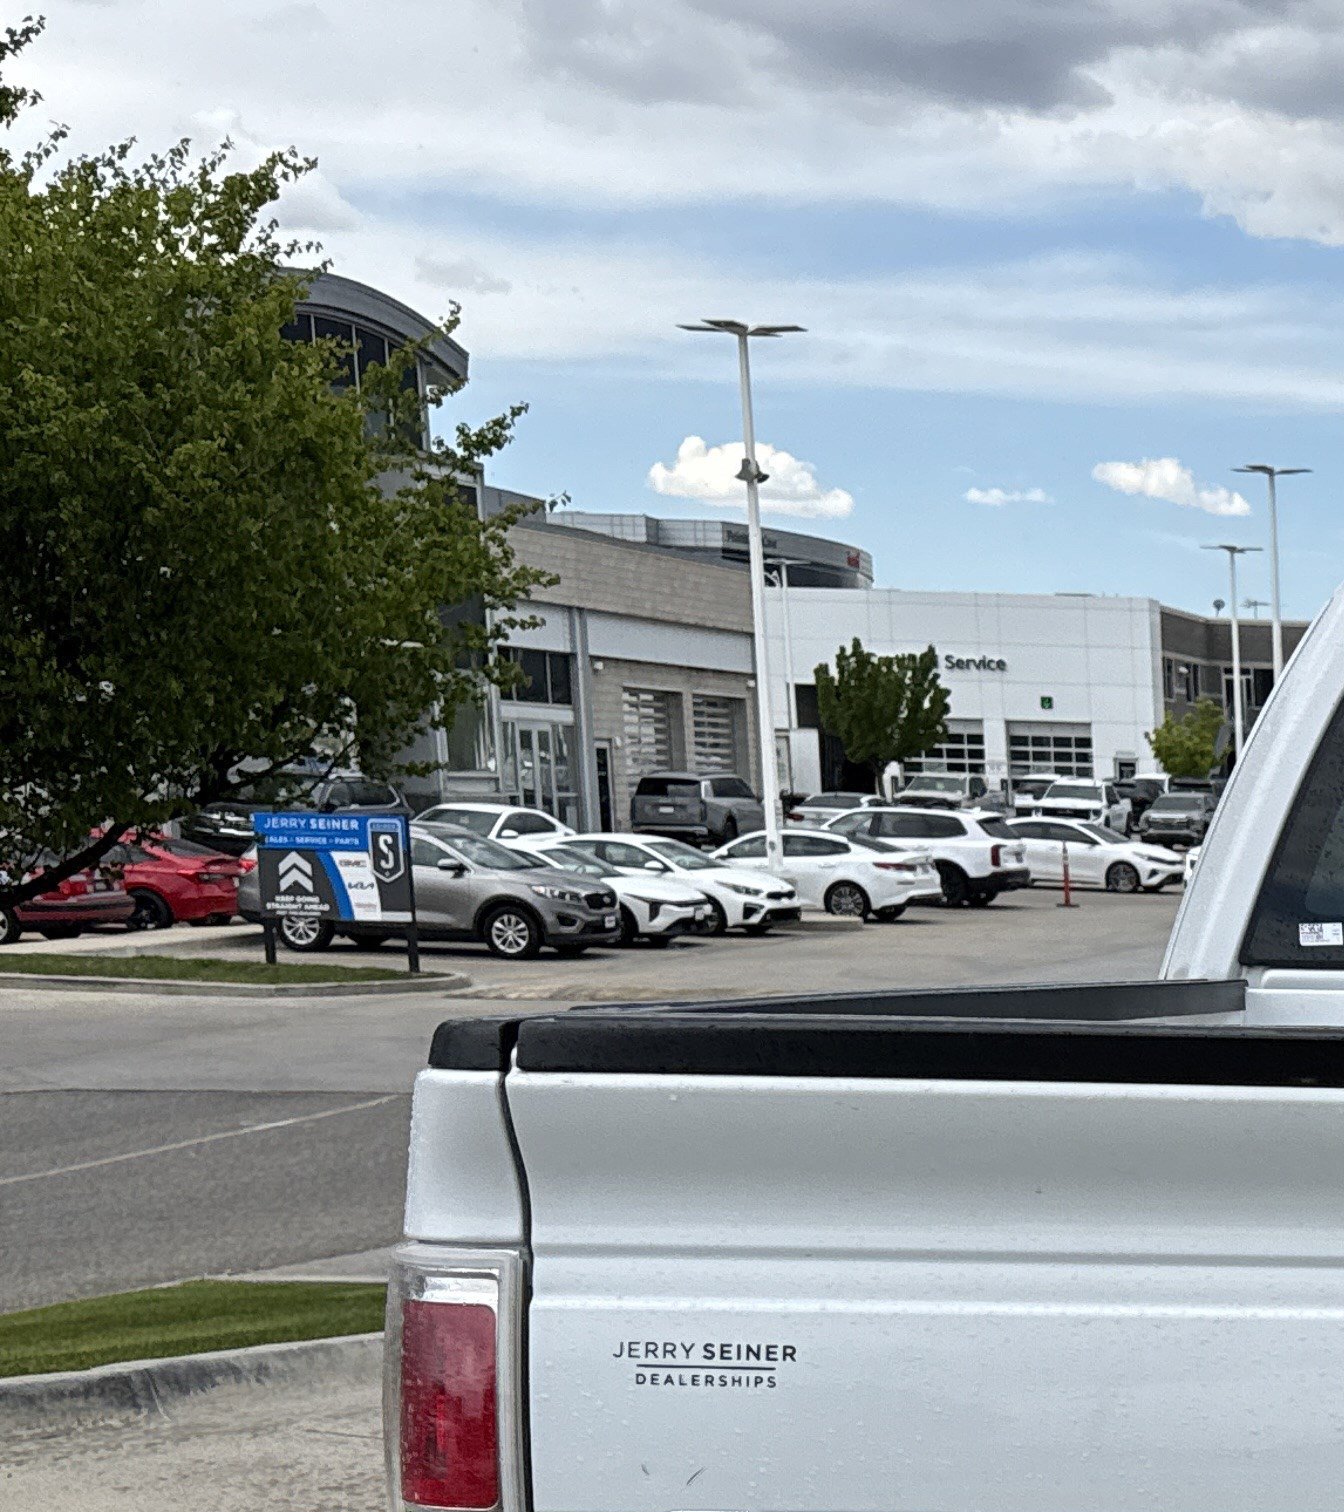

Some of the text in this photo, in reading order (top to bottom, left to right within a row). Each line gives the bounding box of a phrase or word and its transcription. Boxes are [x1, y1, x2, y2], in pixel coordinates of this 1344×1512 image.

[944, 654, 1006, 671] Service
[264, 817, 306, 829] JERRY
[309, 818, 359, 831] SEINER
[379, 834, 395, 869] S
[612, 1341, 797, 1362] JERRY SEINER
[635, 1373, 777, 1388] DEALERSHIPS
